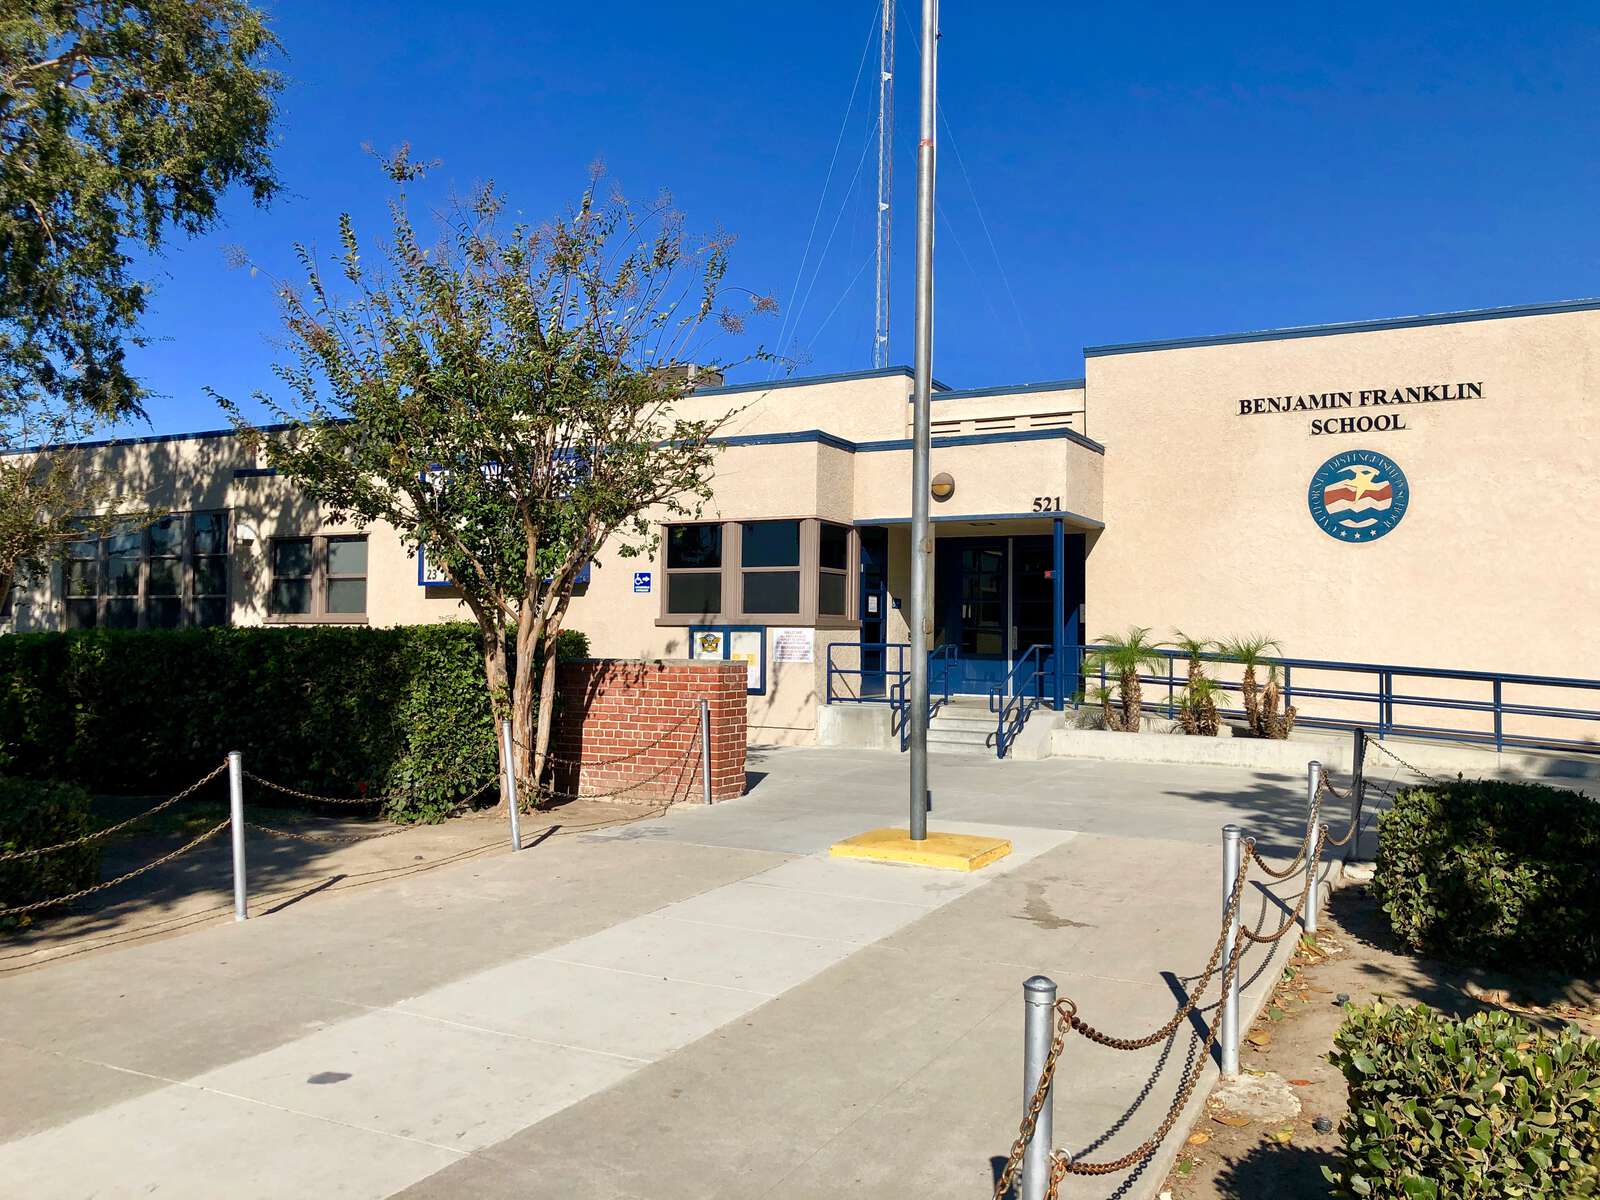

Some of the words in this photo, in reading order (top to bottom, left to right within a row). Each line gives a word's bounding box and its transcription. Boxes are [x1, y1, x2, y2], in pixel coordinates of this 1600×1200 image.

[1239, 391, 1353, 415] BENJAMIN
[1358, 382, 1484, 407] FRANKLIN
[1310, 413, 1406, 436] SCHOOL
[1032, 496, 1062, 512] 521
[426, 569, 437, 580] 23
